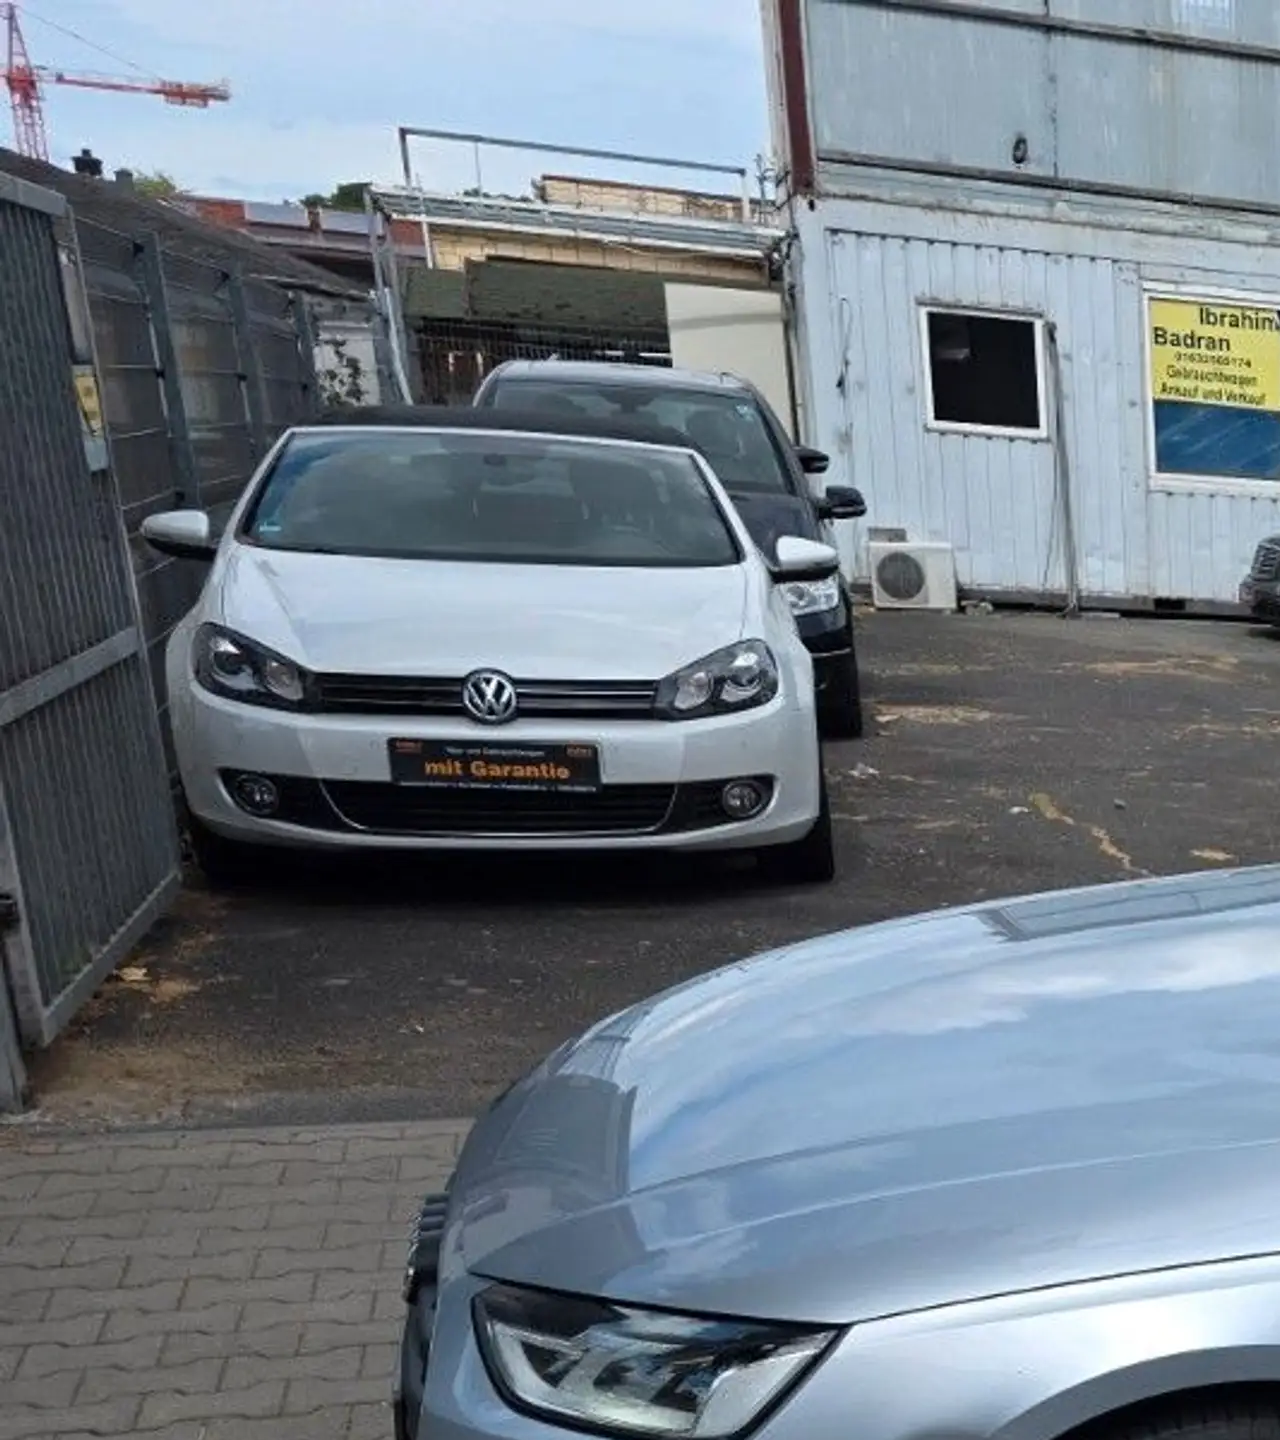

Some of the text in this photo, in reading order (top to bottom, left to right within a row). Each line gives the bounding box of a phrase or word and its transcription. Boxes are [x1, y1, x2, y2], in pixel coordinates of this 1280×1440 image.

[1199, 307, 1280, 331] Ibrahim
[1153, 326, 1231, 350] Badran
[1166, 365, 1257, 387] Gebrauchtwagen
[1161, 382, 1266, 405] Ankauf und Verkauf
[425, 759, 570, 780] mit Garantie
